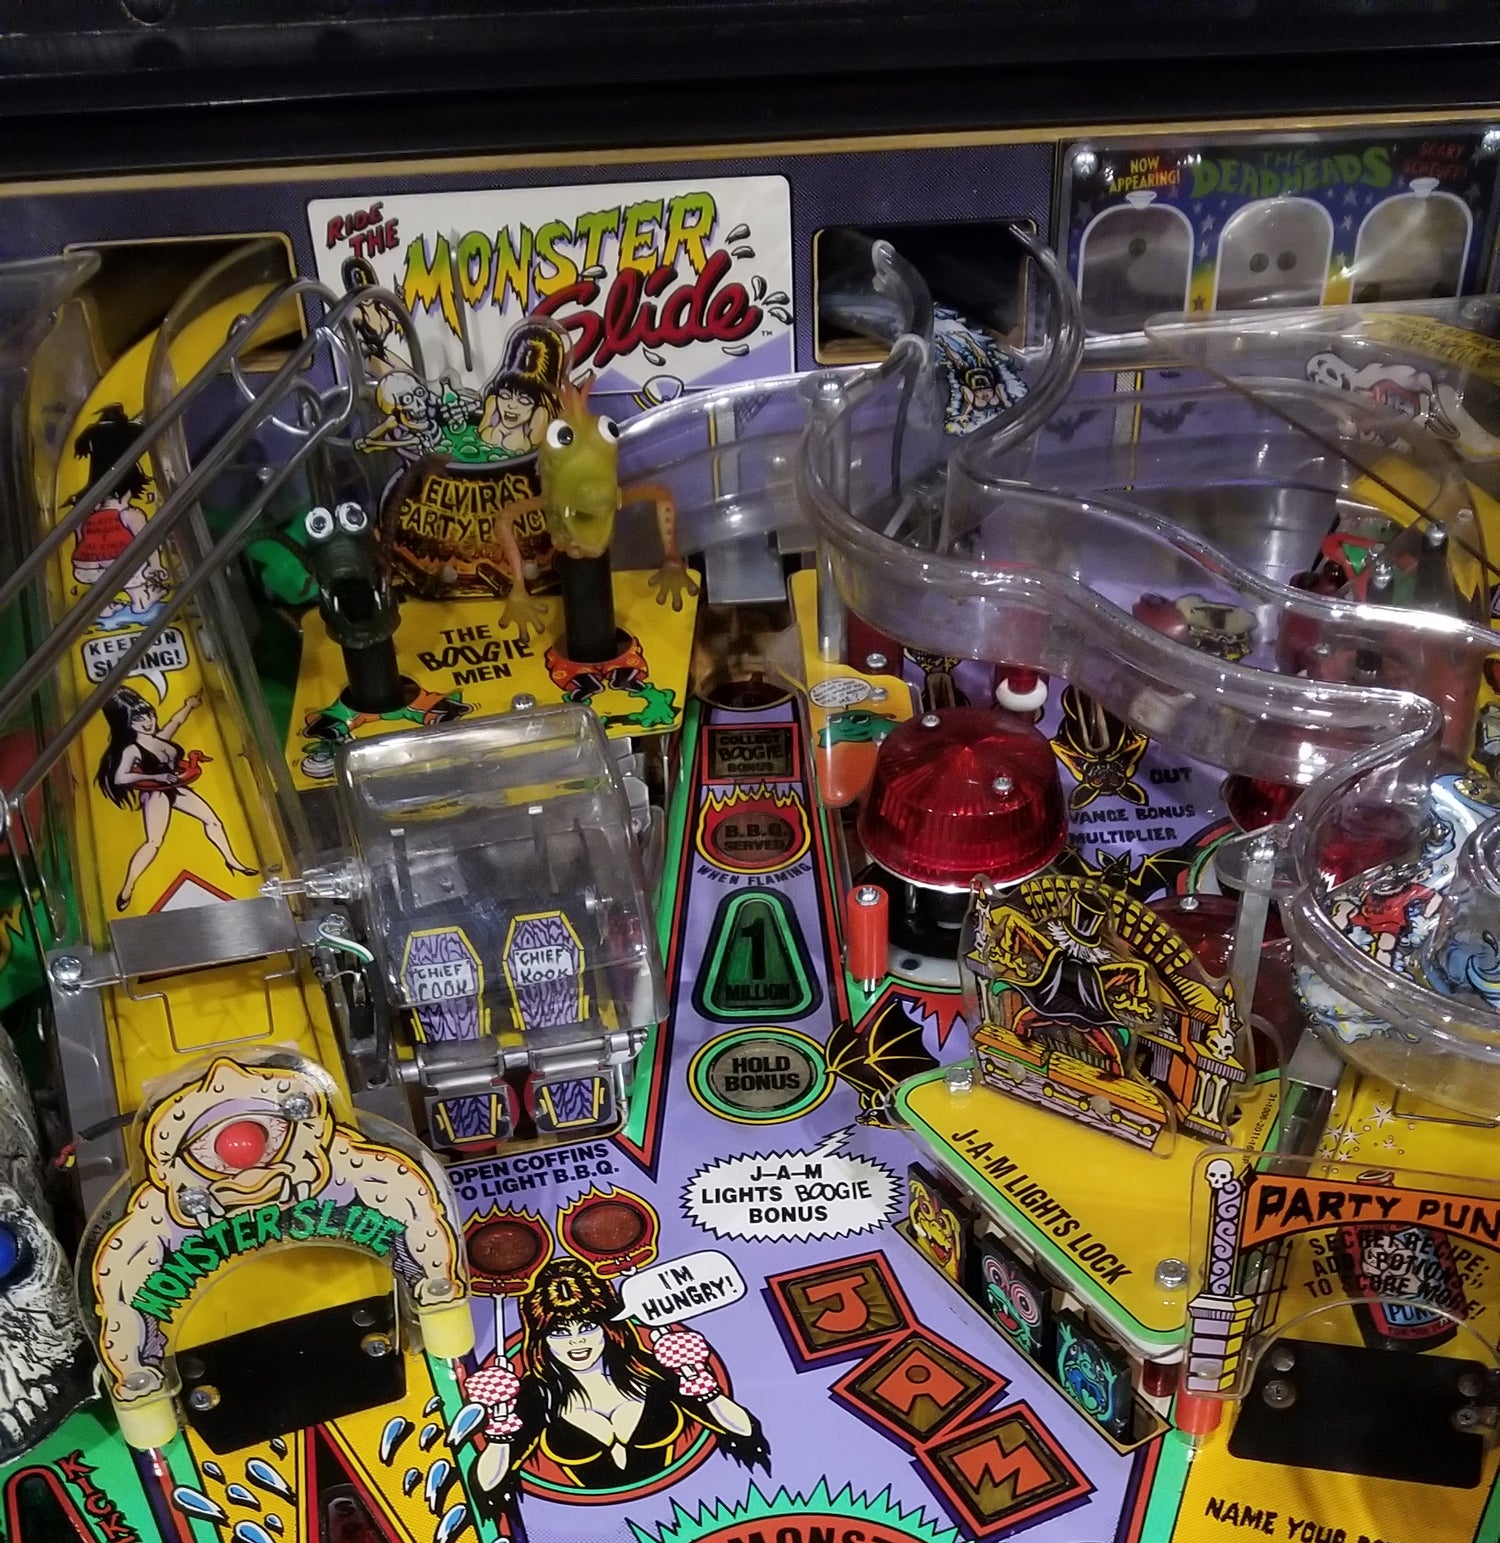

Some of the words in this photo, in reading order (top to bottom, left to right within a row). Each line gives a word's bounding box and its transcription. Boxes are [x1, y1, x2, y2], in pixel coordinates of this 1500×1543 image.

[1130, 155, 1160, 175] NOW
[1190, 147, 1393, 199] DEADHEADS
[1109, 168, 1180, 193] APPEARING!
[326, 202, 385, 248] RIDE
[349, 218, 400, 260] THE
[402, 191, 717, 342] MONSTER
[531, 248, 763, 369] Slide
[425, 474, 533, 510] ELVIRA'S
[400, 500, 473, 541] PARTY
[478, 508, 547, 543] PNC
[440, 625, 492, 645] THE
[93, 649, 182, 677] SLING!
[417, 639, 534, 672] BOOGIE
[453, 663, 512, 686] MEN
[718, 733, 782, 746] COLLECT
[1069, 809, 1129, 825] VANCE
[1136, 805, 1196, 820] BONUS
[1069, 827, 1177, 845] MULTIPLIER
[696, 863, 737, 886] WHEN
[748, 862, 813, 886] FLAMING
[740, 917, 767, 981] 1
[725, 982, 792, 1001] MILLION
[732, 1055, 791, 1074] HOLD
[724, 1072, 800, 1093] BONUS
[450, 1162, 510, 1185] OPEN
[513, 1143, 609, 1173] COFFINS
[482, 1172, 549, 1198] LIGHT
[553, 1160, 619, 1184] B.B.Q.
[701, 1184, 783, 1205] LIGHTS
[795, 1180, 873, 1202] BOOGIE
[951, 1129, 1017, 1184] J-A-M
[1003, 1173, 1080, 1238] LIGHTS
[1068, 1222, 1132, 1286] LOCK
[749, 1205, 828, 1224] BONUS
[1254, 1185, 1402, 1233] PARTY
[131, 1203, 282, 1324] MONSTER
[290, 1199, 408, 1256] SLIDE
[658, 1266, 696, 1290] I'M
[1304, 1278, 1333, 1299] TO
[642, 1276, 738, 1320] HUNGRY!
[1205, 1496, 1277, 1538] NAME
